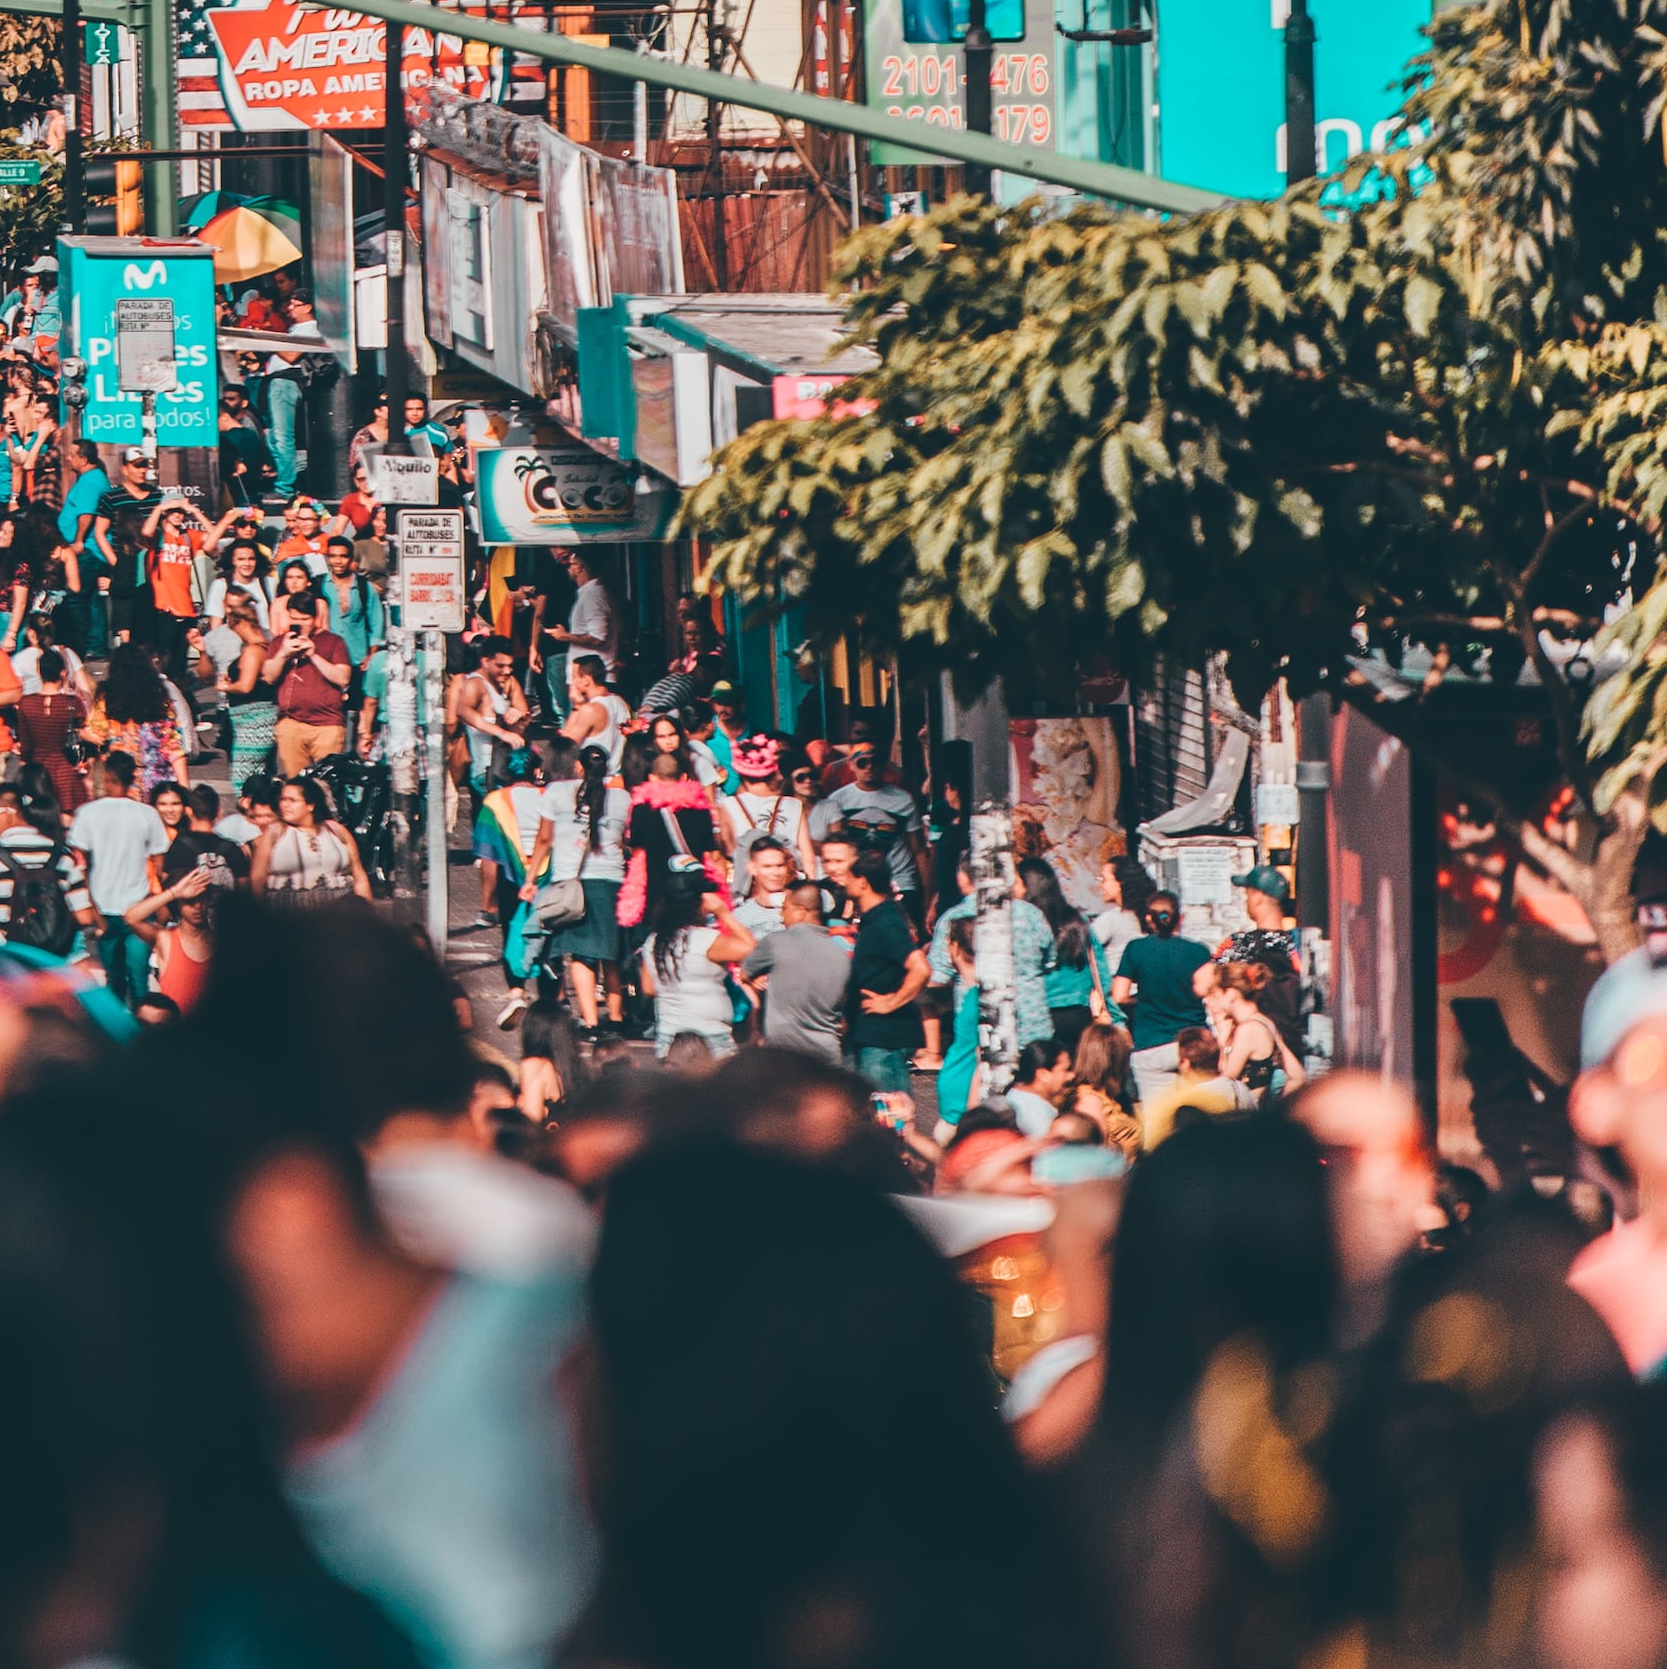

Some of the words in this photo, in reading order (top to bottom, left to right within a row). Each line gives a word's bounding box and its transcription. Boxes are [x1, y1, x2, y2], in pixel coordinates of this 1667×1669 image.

[883, 53, 1049, 96] 2101-476
[244, 78, 317, 102] ROPA
[19, 168, 26, 177] 9
[120, 302, 153, 310] PARADA
[158, 302, 170, 310] DE
[121, 312, 172, 320] AUTOBUSES
[88, 413, 137, 436] para
[408, 518, 439, 527] PARADA
[443, 518, 452, 527] DE
[407, 530, 454, 539] AUTOBUSES
